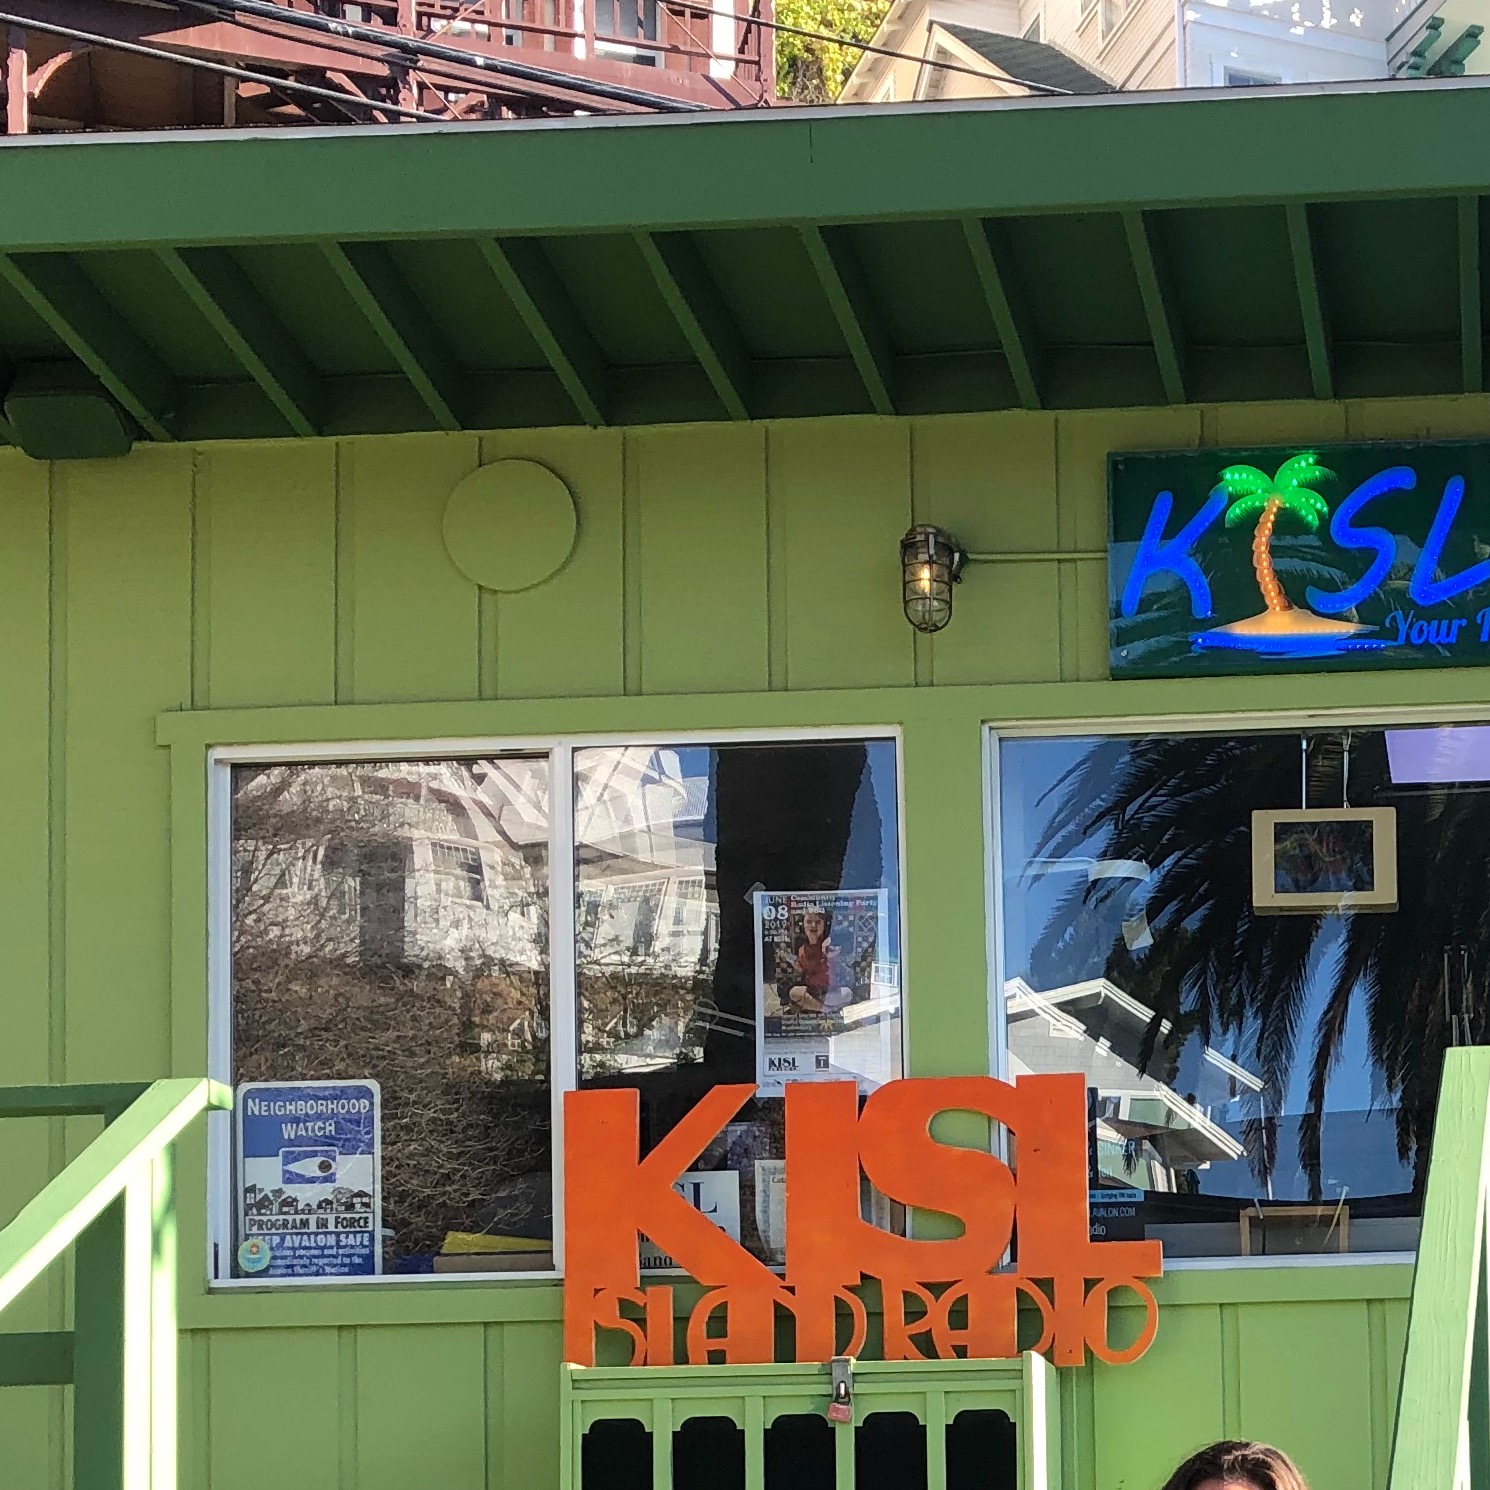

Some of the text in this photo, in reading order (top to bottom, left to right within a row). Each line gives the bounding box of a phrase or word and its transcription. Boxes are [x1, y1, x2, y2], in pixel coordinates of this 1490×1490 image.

[1385, 609, 1468, 646] Your
[764, 895, 788, 904] JUNE
[855, 899, 878, 908] Party
[763, 904, 789, 920] 08
[764, 920, 788, 929] 2019
[768, 1056, 799, 1070] KISL
[247, 1098, 370, 1117] NEIGHBORHOOD
[281, 1120, 336, 1140] WATCH
[563, 1072, 1163, 1286] KISL
[248, 1215, 370, 1232] PROGRAM IN FORCE
[283, 1233, 337, 1248] AVALON
[339, 1233, 370, 1246] SAFE
[564, 1276, 1159, 1366] ISLAND RADIO
